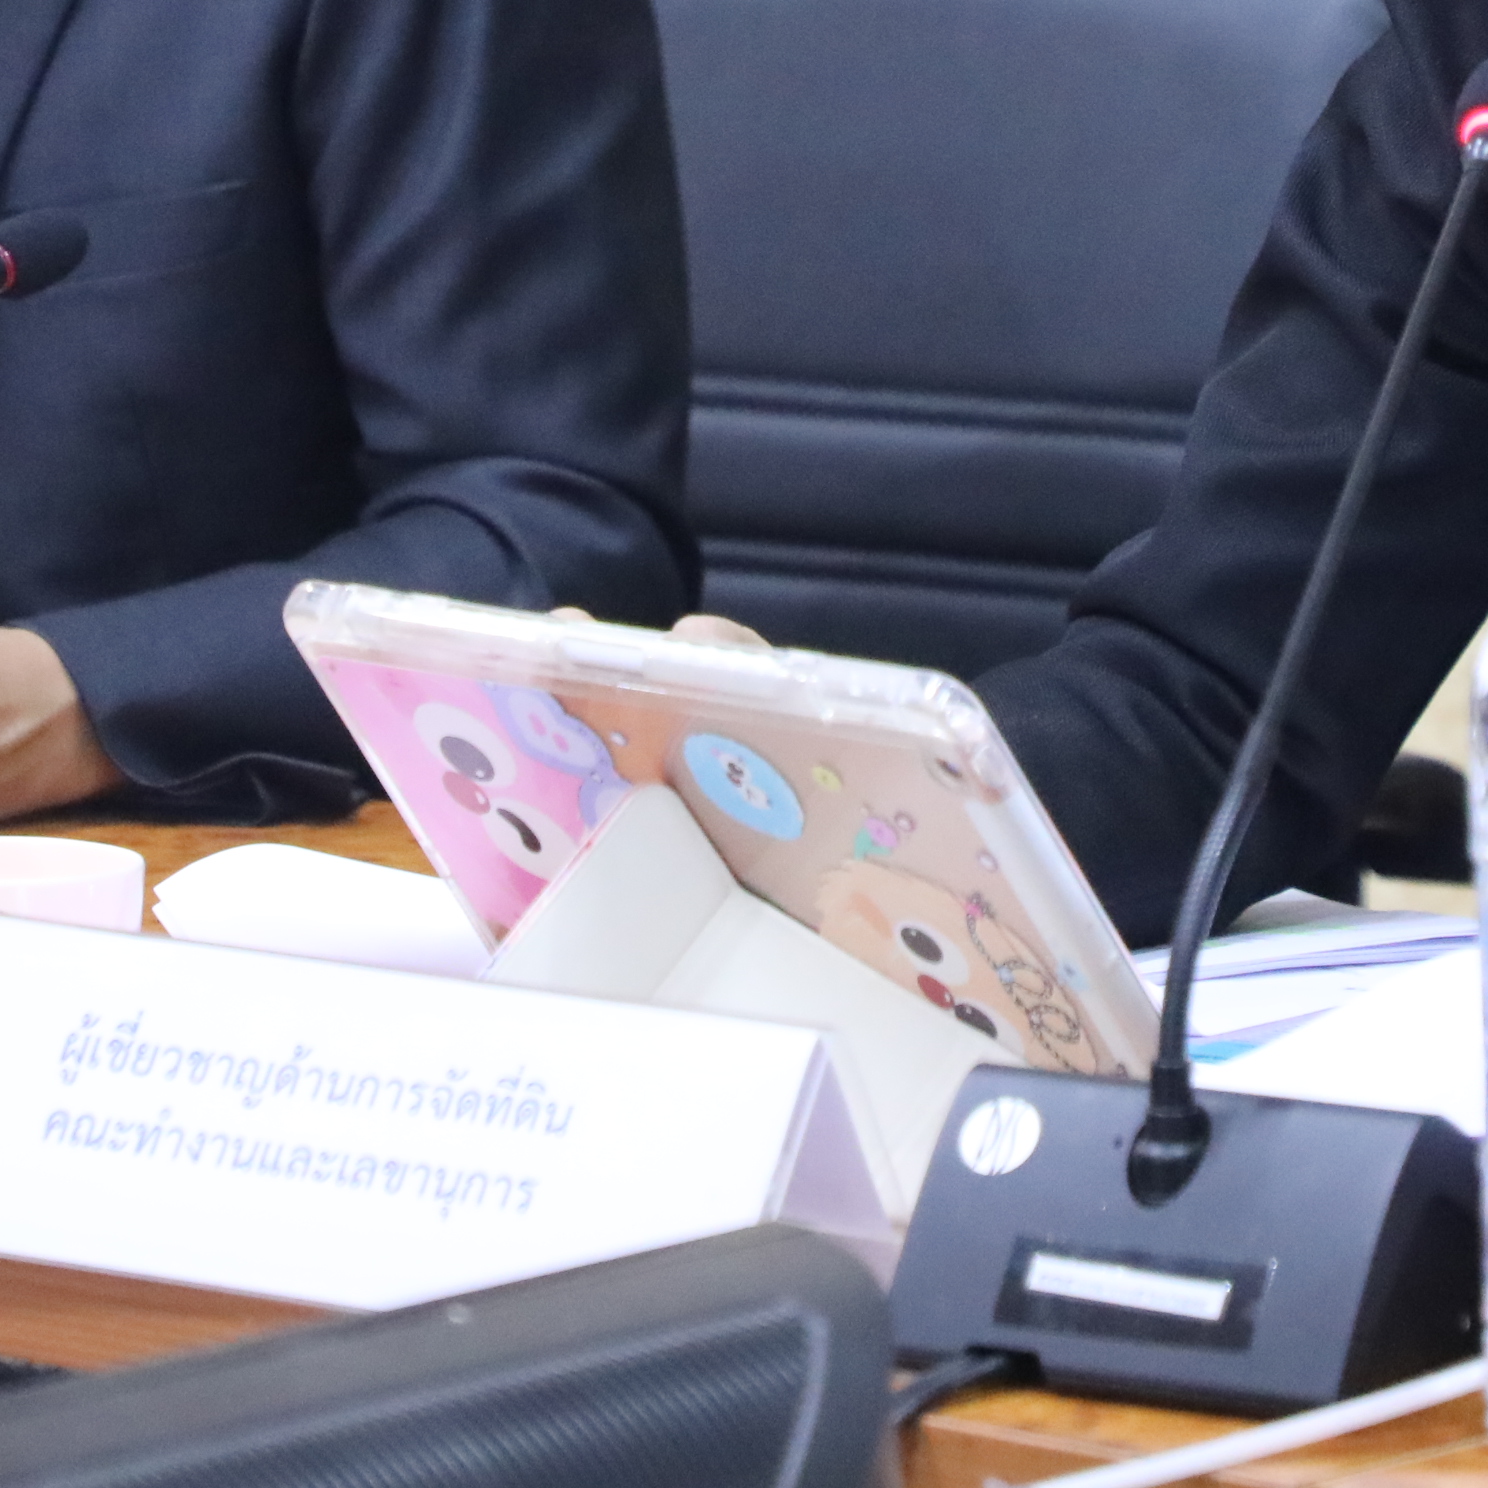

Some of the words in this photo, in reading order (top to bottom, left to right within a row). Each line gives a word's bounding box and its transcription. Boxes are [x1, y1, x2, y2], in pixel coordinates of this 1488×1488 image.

[58, 1011, 574, 1137] ผู้เชี่ยวชาญด้านการจัดที่ดิน
[42, 1107, 540, 1221] คณะทำงานและเลขานุการ
